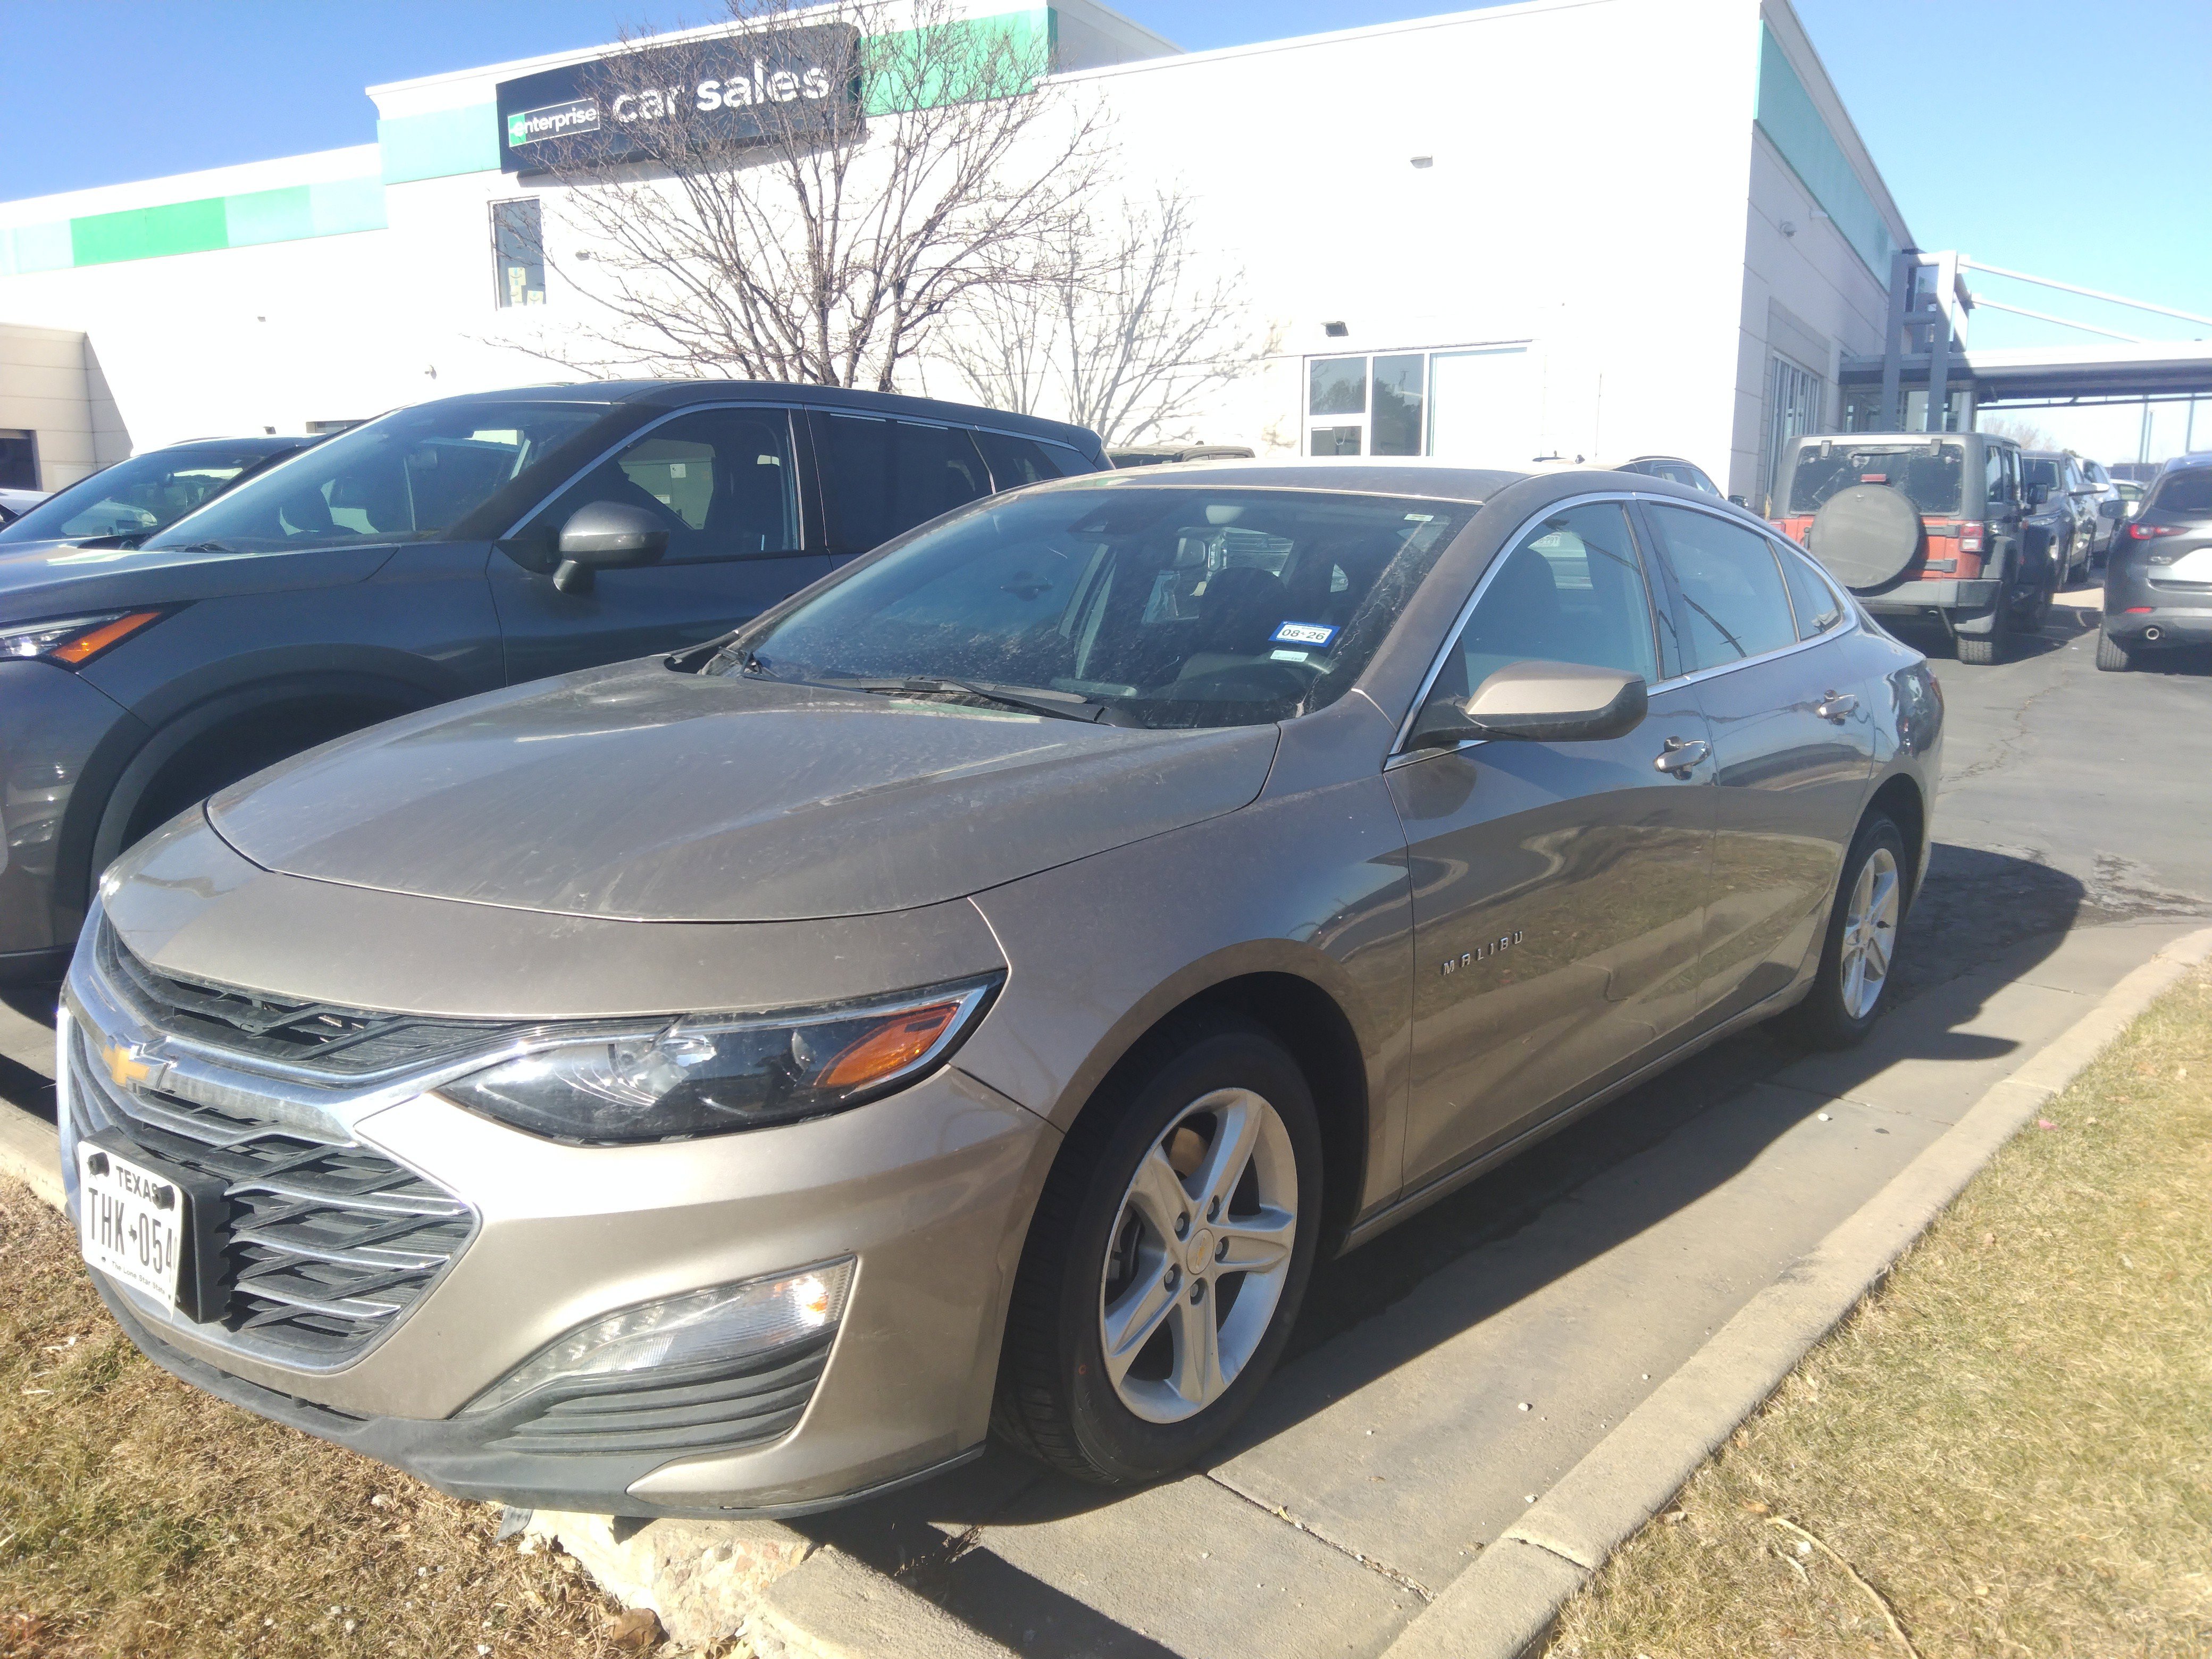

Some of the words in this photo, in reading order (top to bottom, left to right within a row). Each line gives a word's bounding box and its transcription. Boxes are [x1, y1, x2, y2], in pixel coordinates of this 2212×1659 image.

[613, 85, 685, 123] car
[697, 58, 830, 112] sales
[510, 107, 597, 137] enterprise
[1442, 931, 1523, 976] MALIBU
[115, 1166, 158, 1203] TEXAS
[112, 1261, 122, 1271] The
[123, 1267, 137, 1279] Lone
[139, 1275, 151, 1286] Star
[152, 1282, 165, 1295] State
